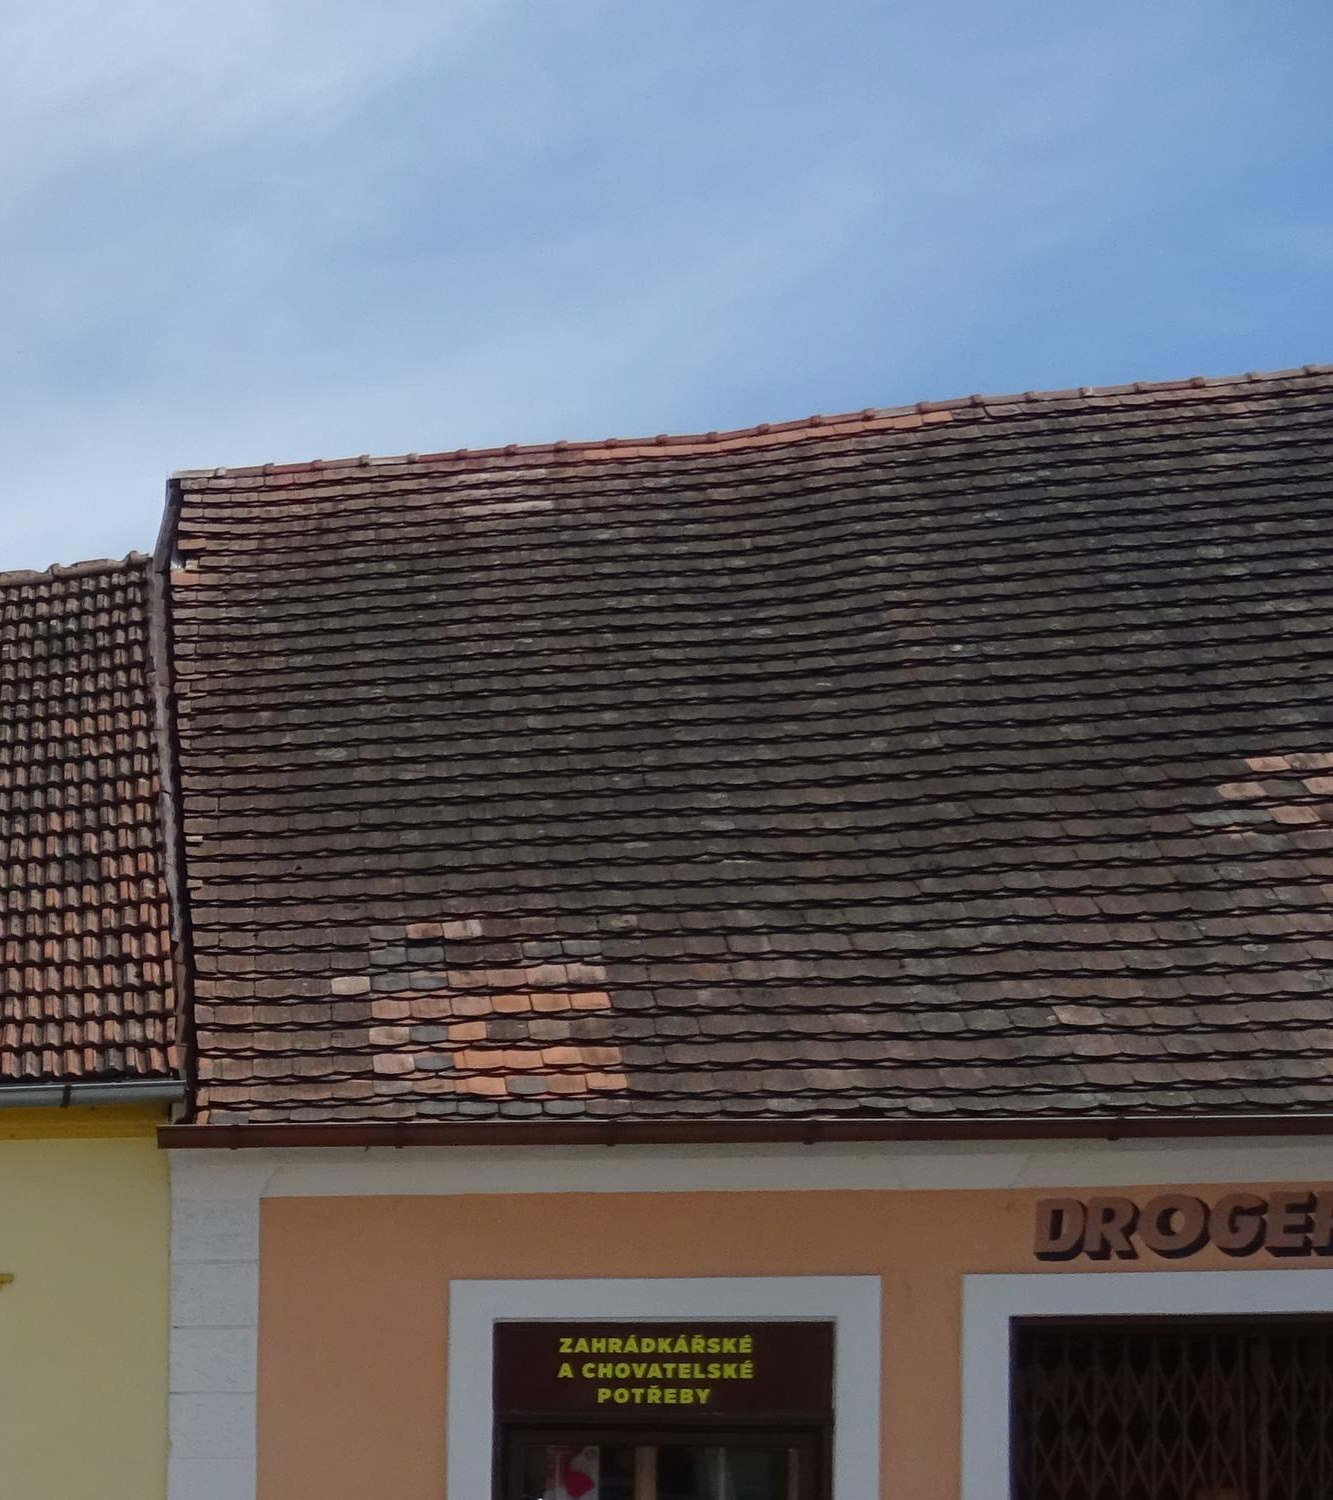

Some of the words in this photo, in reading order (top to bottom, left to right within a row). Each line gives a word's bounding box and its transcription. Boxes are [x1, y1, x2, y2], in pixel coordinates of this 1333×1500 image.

[558, 1335, 753, 1353] ZAHRÁDKÁŘSKÉ
[557, 1363, 573, 1378] A
[582, 1360, 754, 1379] CHOVATELSKÉ
[597, 1385, 711, 1404] POTŘEBY
